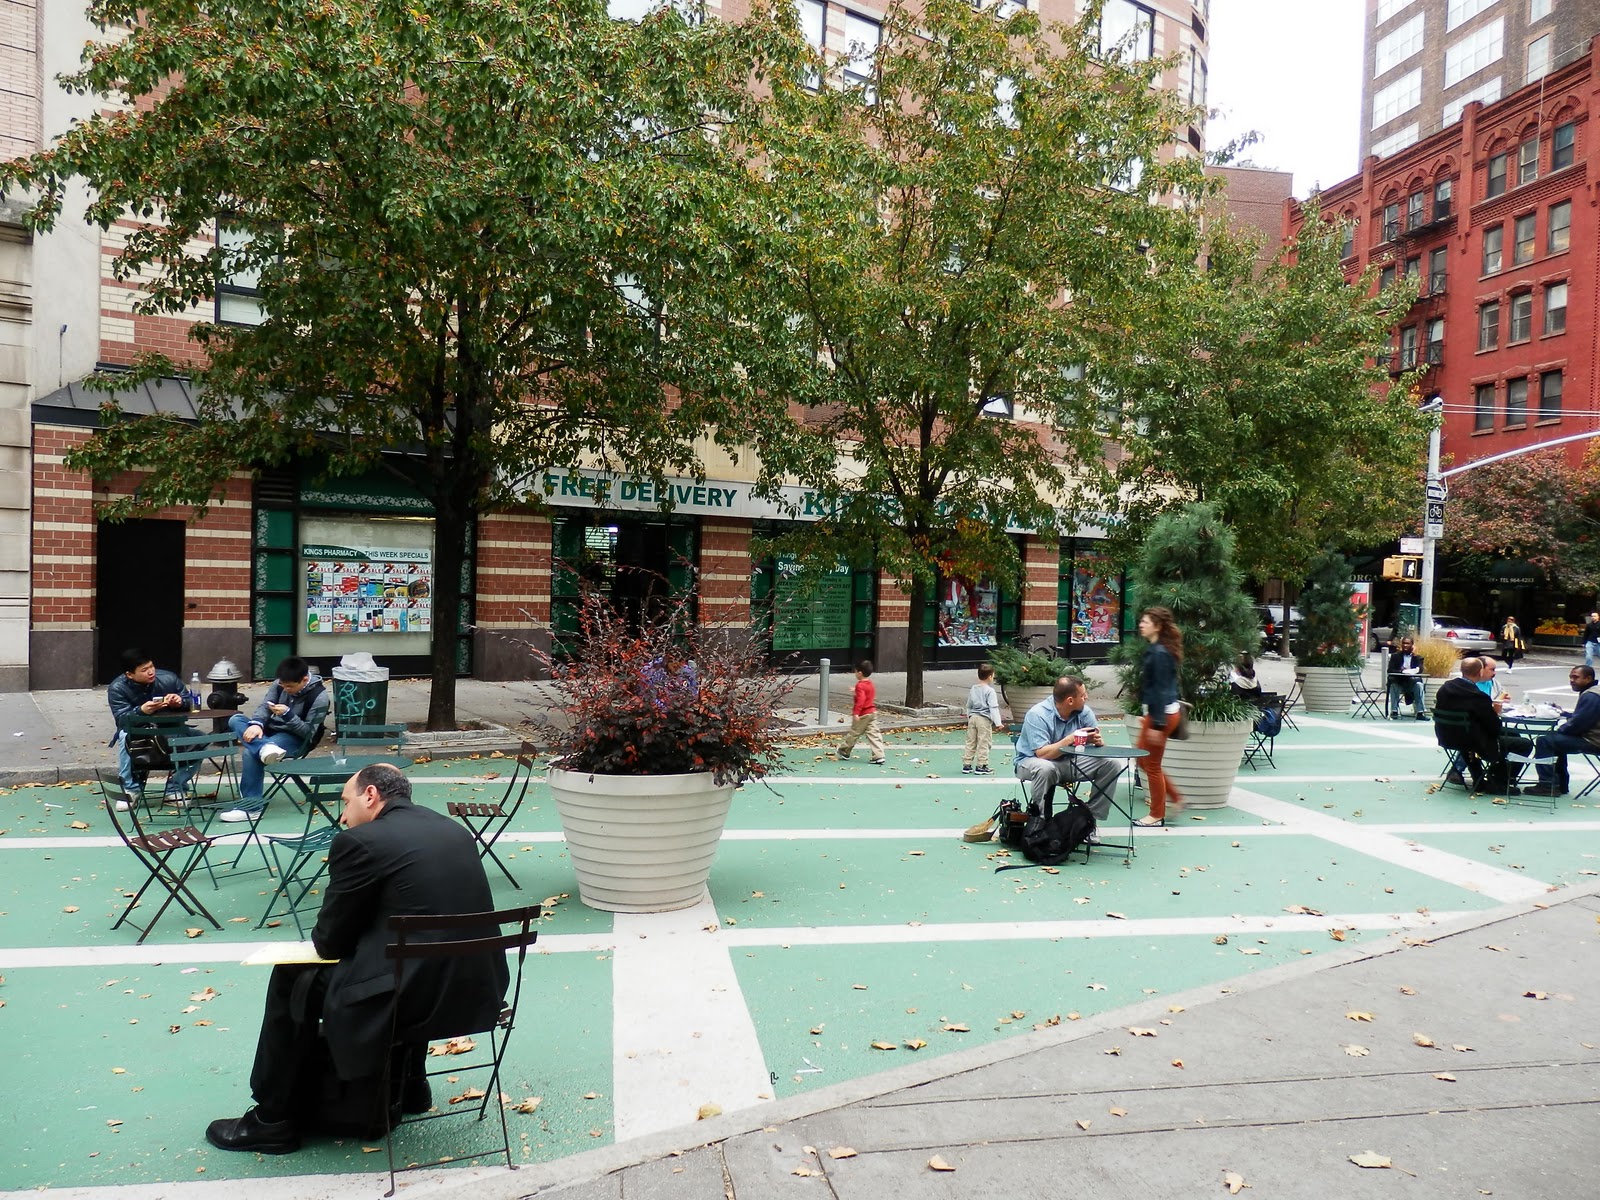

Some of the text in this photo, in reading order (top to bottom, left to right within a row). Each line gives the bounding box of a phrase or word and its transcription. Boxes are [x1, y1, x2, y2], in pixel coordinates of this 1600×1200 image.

[543, 475, 738, 508] FREE DELIVERY
[303, 548, 323, 556] KINGS
[323, 548, 358, 557] PHARMACY
[365, 550, 379, 558] THIS
[399, 551, 429, 559] SPECIALS
[834, 563, 850, 575] Day
